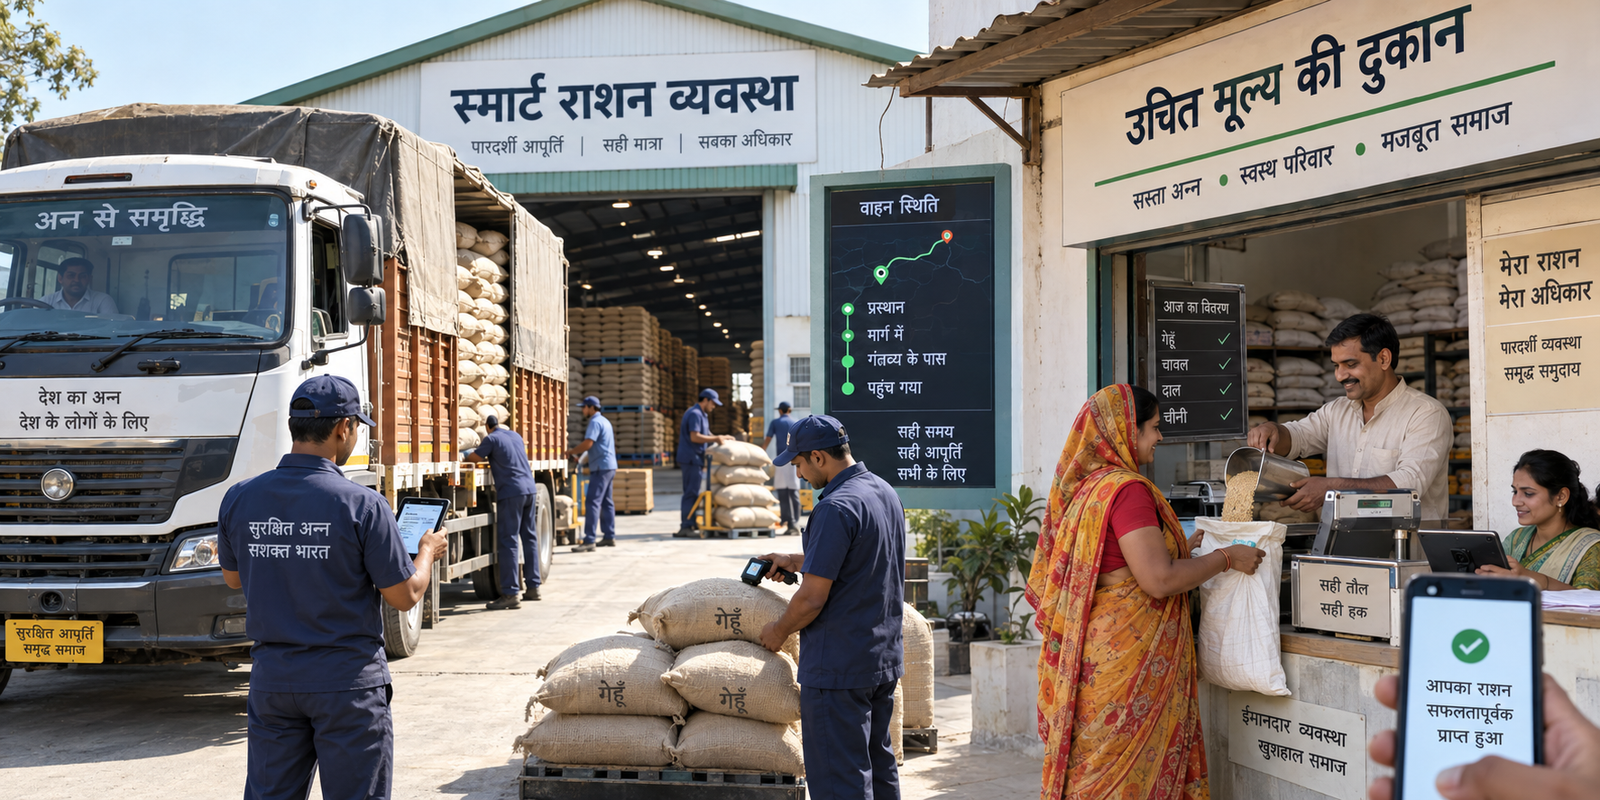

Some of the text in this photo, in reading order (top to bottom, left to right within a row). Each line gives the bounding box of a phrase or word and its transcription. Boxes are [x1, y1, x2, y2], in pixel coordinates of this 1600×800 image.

[1125, 4, 1472, 145] उचित मूल्य की दुकान
[451, 73, 799, 124] स्मार्ट राशन व्यवस्था
[471, 129, 793, 157] पारदर्शी आपूर्ति सही मात्रा सबका अधिकार
[1133, 102, 1512, 209] सस्ता अन्न स्वस्थ परिवार मजबूत समाज
[860, 194, 939, 217] वाहन स्थिति
[93, 203, 119, 228] से
[1499, 249, 1581, 276] मेरा राशन
[1499, 279, 1593, 309] मेरा अधिकार
[867, 302, 905, 314] प्रस्थान
[1164, 298, 1229, 314] आज का वितरण
[867, 325, 904, 341] मार्ग में
[1501, 335, 1582, 354] पारदर्शी व्यवस्था
[907, 349, 919, 365] के
[923, 353, 947, 365] पास
[1162, 359, 1189, 371] चावल
[1538, 363, 1581, 382] समुदाय
[39, 386, 121, 405] देश का अन्न
[867, 379, 922, 399] पहुंच गया
[1162, 385, 1181, 397] दाल
[19, 411, 149, 431] देश के लोगों के लिए
[1164, 407, 1188, 424] चीनी
[897, 422, 954, 439] सही समय
[897, 443, 962, 462] सही आपूर्ति
[897, 464, 966, 482] सभी के लिए
[249, 517, 331, 539] सुरक्षित अन्न
[248, 544, 330, 559] सशक्त भारत
[1319, 577, 1369, 595] सही तौल
[1320, 600, 1368, 619] सही हक
[16, 625, 94, 643] सुरक्षित आपूर्ति
[55, 645, 86, 655] समाज
[1426, 680, 1512, 697] आपका राशन
[1427, 704, 1513, 724] सफलतापूर्वक
[1242, 705, 1347, 747] ईमानदार व्यवस्था
[1437, 730, 1503, 748] प्राप्त हुआ
[1258, 740, 1347, 776] खुशहाल समाज
